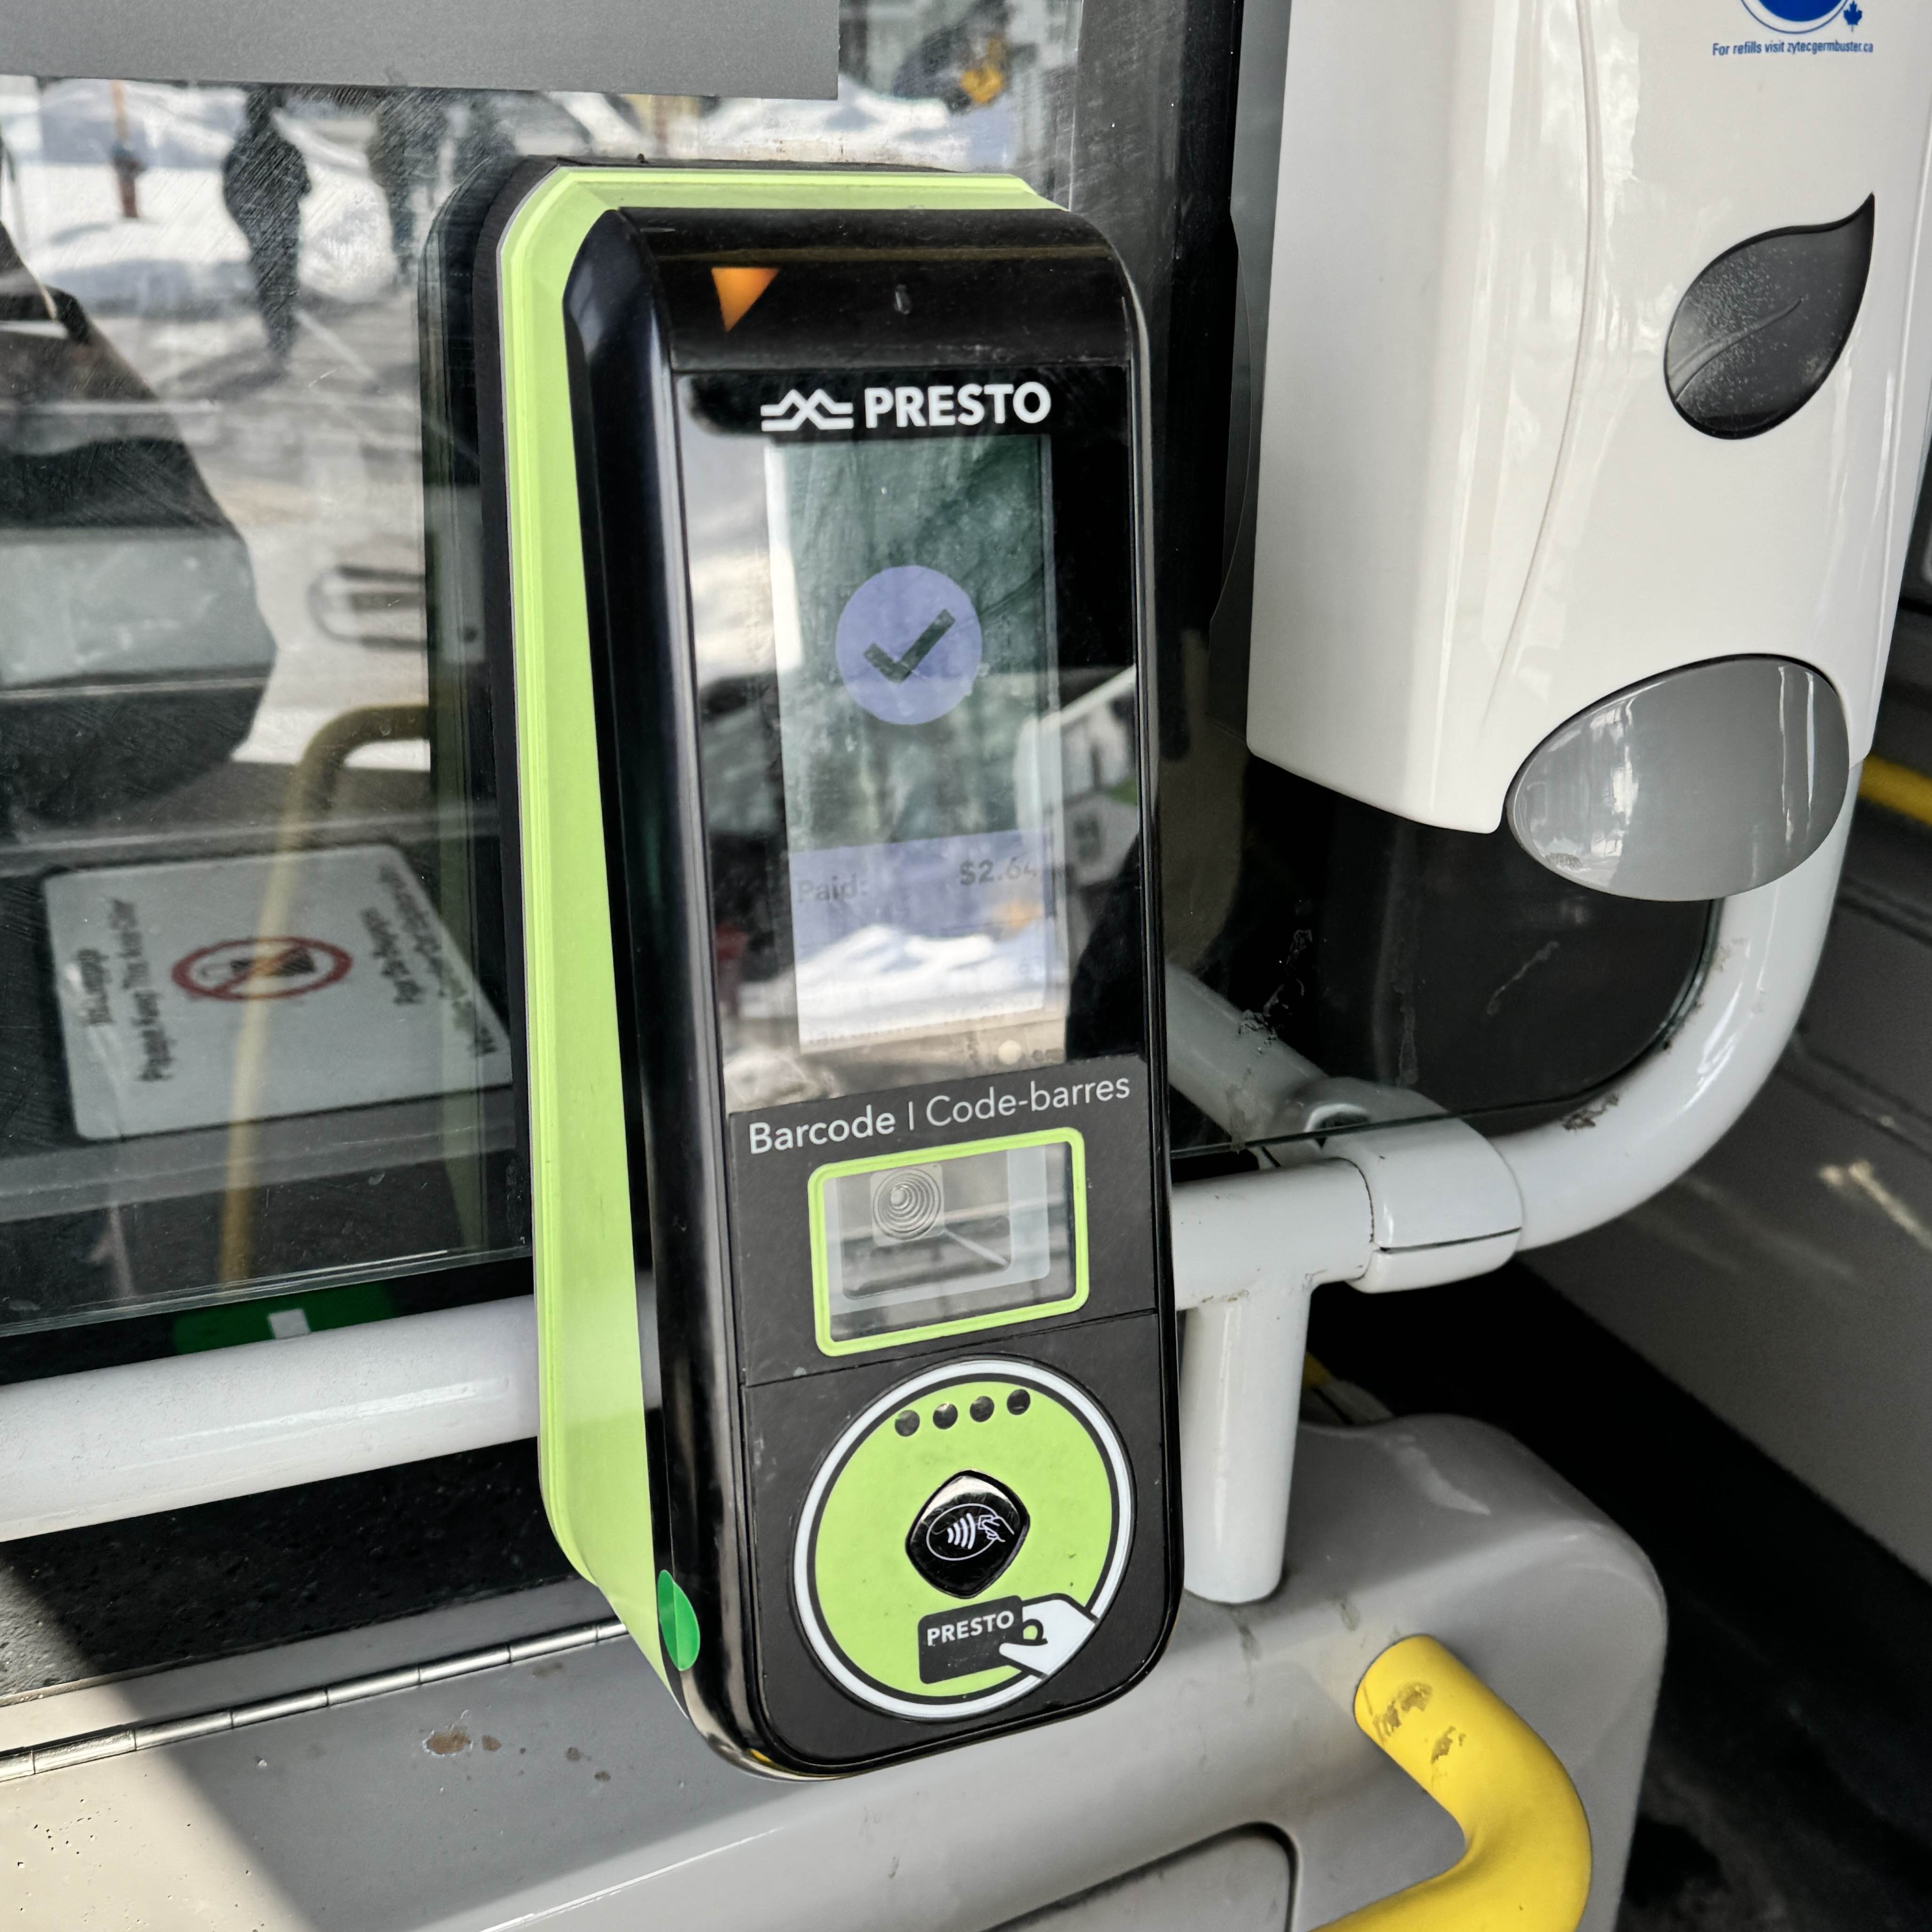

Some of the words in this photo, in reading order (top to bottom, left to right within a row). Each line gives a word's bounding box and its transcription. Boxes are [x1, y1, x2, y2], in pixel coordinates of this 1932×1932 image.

[1712, 42, 1730, 56] For
[1732, 40, 1762, 54] refills
[1764, 39, 1785, 53] visit
[1786, 39, 1874, 54] zytecgermbuster.ca
[864, 381, 1052, 428] PRESTO
[748, 1104, 896, 1155] Barcode
[926, 1077, 1131, 1127] Code-barres
[926, 1610, 1015, 1647] PRESTO
